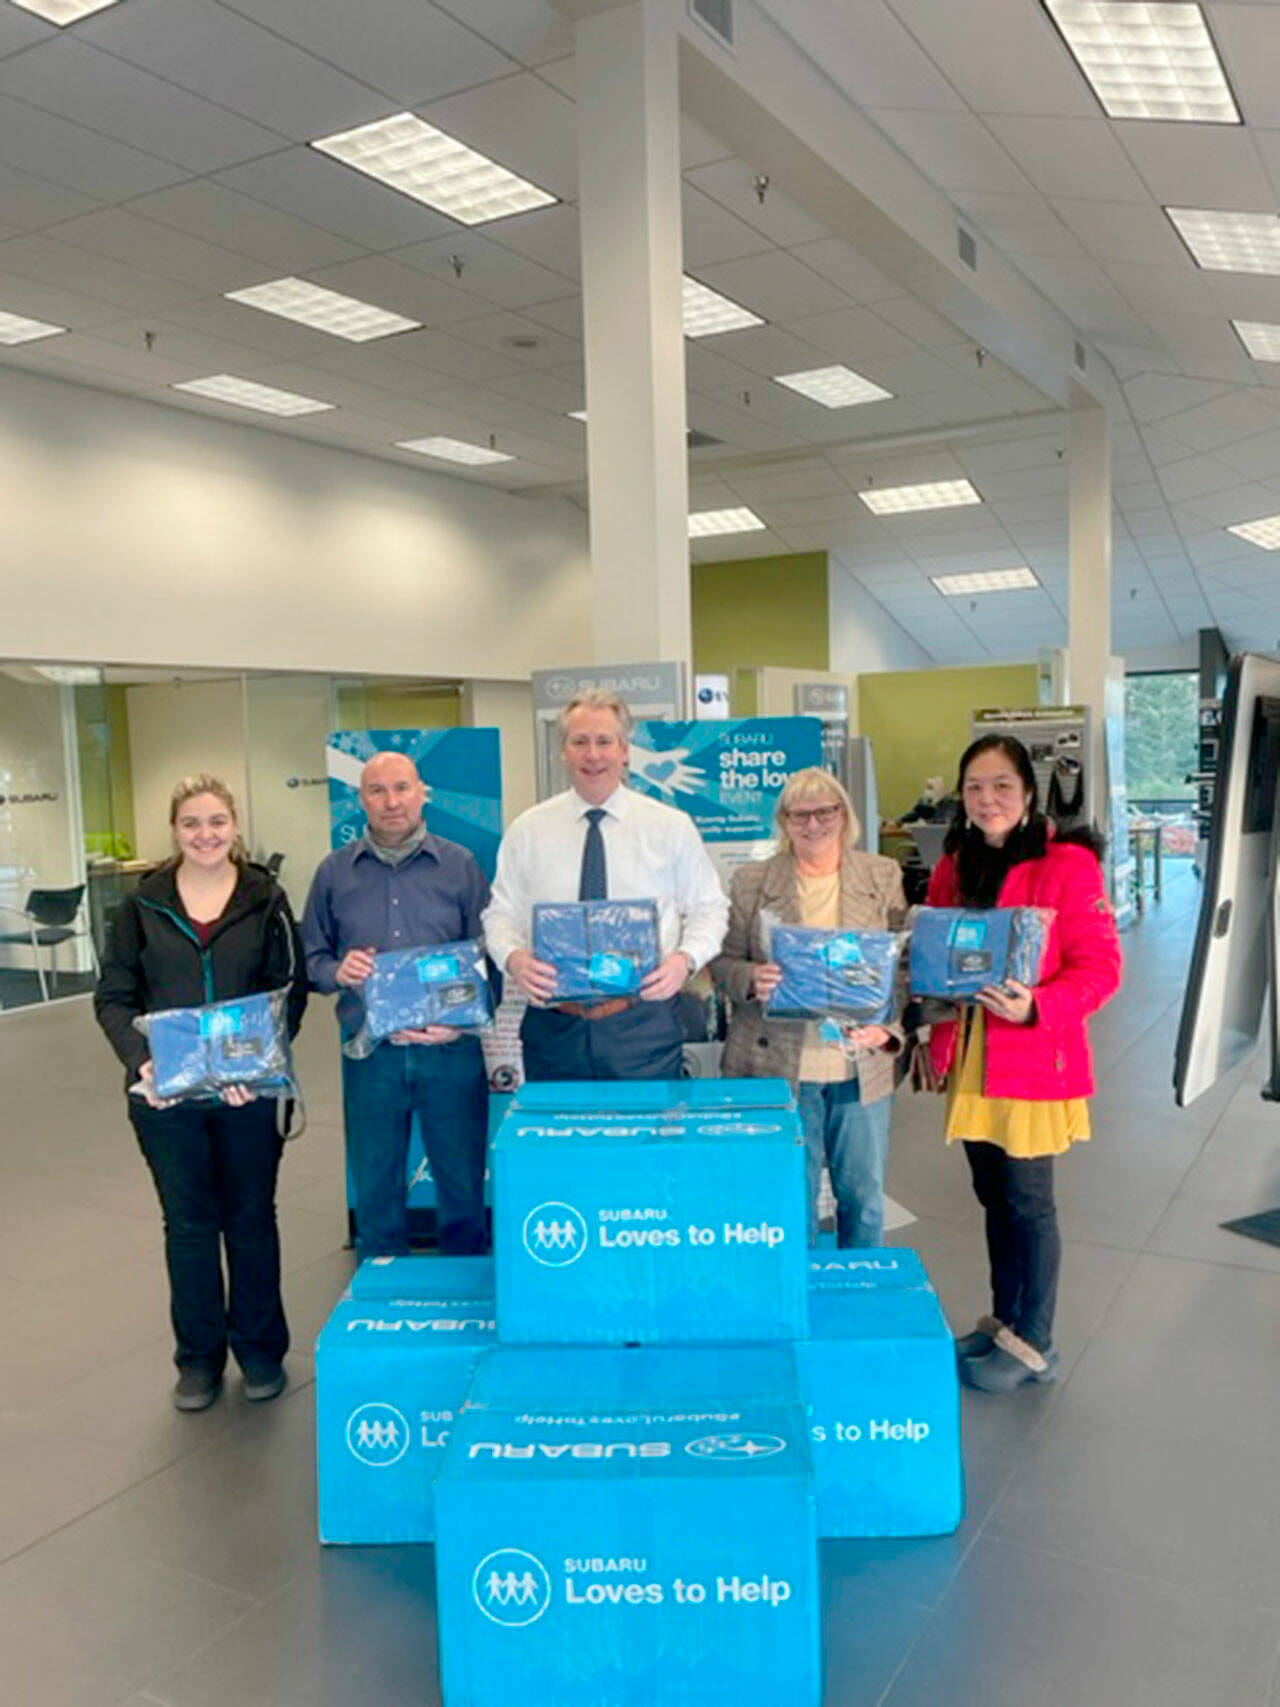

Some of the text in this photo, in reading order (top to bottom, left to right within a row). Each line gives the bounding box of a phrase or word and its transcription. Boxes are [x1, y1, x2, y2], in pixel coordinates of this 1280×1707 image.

[719, 747, 787, 768] share
[720, 766, 793, 789] the lov
[517, 1126, 686, 1137] SUBARU
[599, 1207, 668, 1221] SUBARU
[599, 1221, 785, 1249] Loves to Help
[420, 1410, 453, 1422] SUB
[836, 1421, 862, 1441] to
[869, 1417, 930, 1444] Help
[468, 1441, 672, 1459] SUBARU
[564, 1557, 647, 1574] SUBARU
[565, 1573, 792, 1608] Loves to Help
